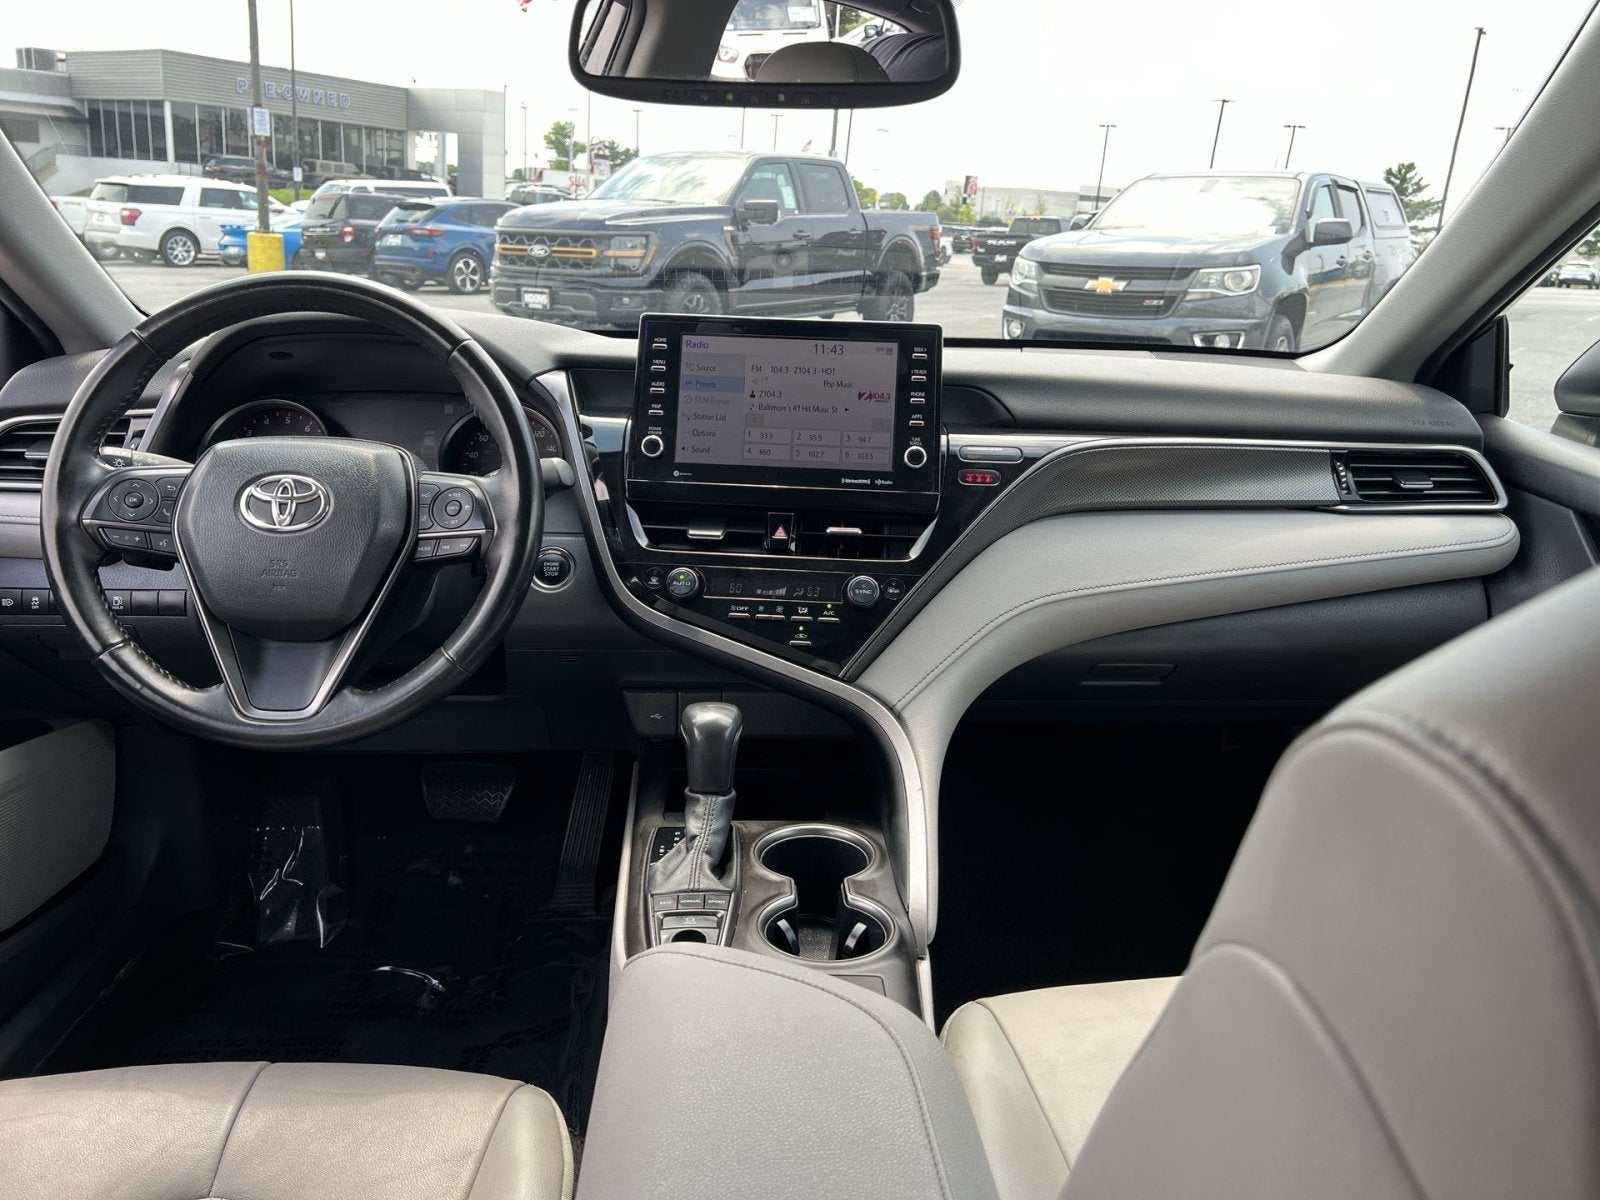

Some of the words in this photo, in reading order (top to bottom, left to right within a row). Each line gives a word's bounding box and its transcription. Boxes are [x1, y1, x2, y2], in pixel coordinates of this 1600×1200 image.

[236, 77, 351, 108] PE-OWNED
[685, 339, 710, 349] Radio
[814, 343, 845, 355] 11:43
[696, 362, 717, 372] Source
[751, 365, 762, 373] FM
[770, 366, 789, 374] 104.3
[695, 380, 717, 388] Presets
[823, 380, 835, 389] Pop
[759, 390, 782, 399] Z104.3
[793, 404, 801, 412] #1
[812, 405, 830, 413] Music
[693, 412, 714, 421] Station
[716, 413, 727, 421] List
[478, 434, 489, 442] 60
[534, 430, 545, 438] 120
[692, 429, 716, 438] Options
[691, 445, 711, 454] Sound
[468, 451, 479, 459] 40
[270, 559, 289, 568] SRS
[261, 569, 298, 578] AIRBAG
